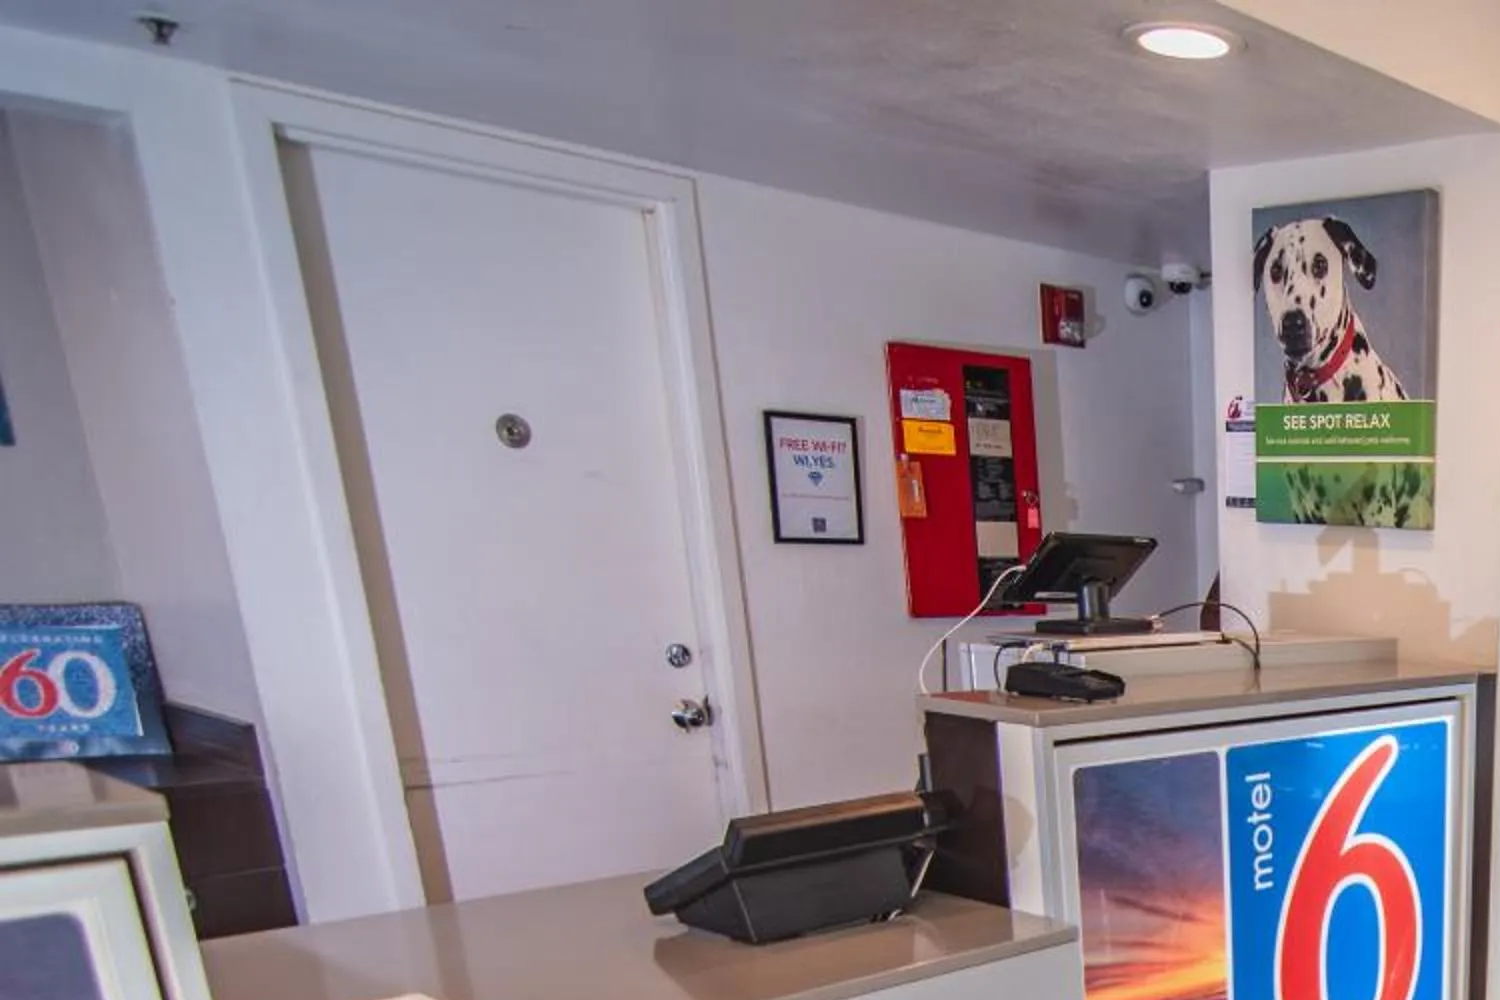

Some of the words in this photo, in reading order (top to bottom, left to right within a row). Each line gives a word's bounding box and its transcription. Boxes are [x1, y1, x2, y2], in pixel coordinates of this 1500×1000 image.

[1283, 414, 1307, 431] SEE
[1309, 413, 1343, 430] SPOT
[1345, 412, 1391, 429] RELAX
[779, 437, 810, 452] FREE
[0, 648, 117, 719] 60
[1244, 771, 1274, 891] motel
